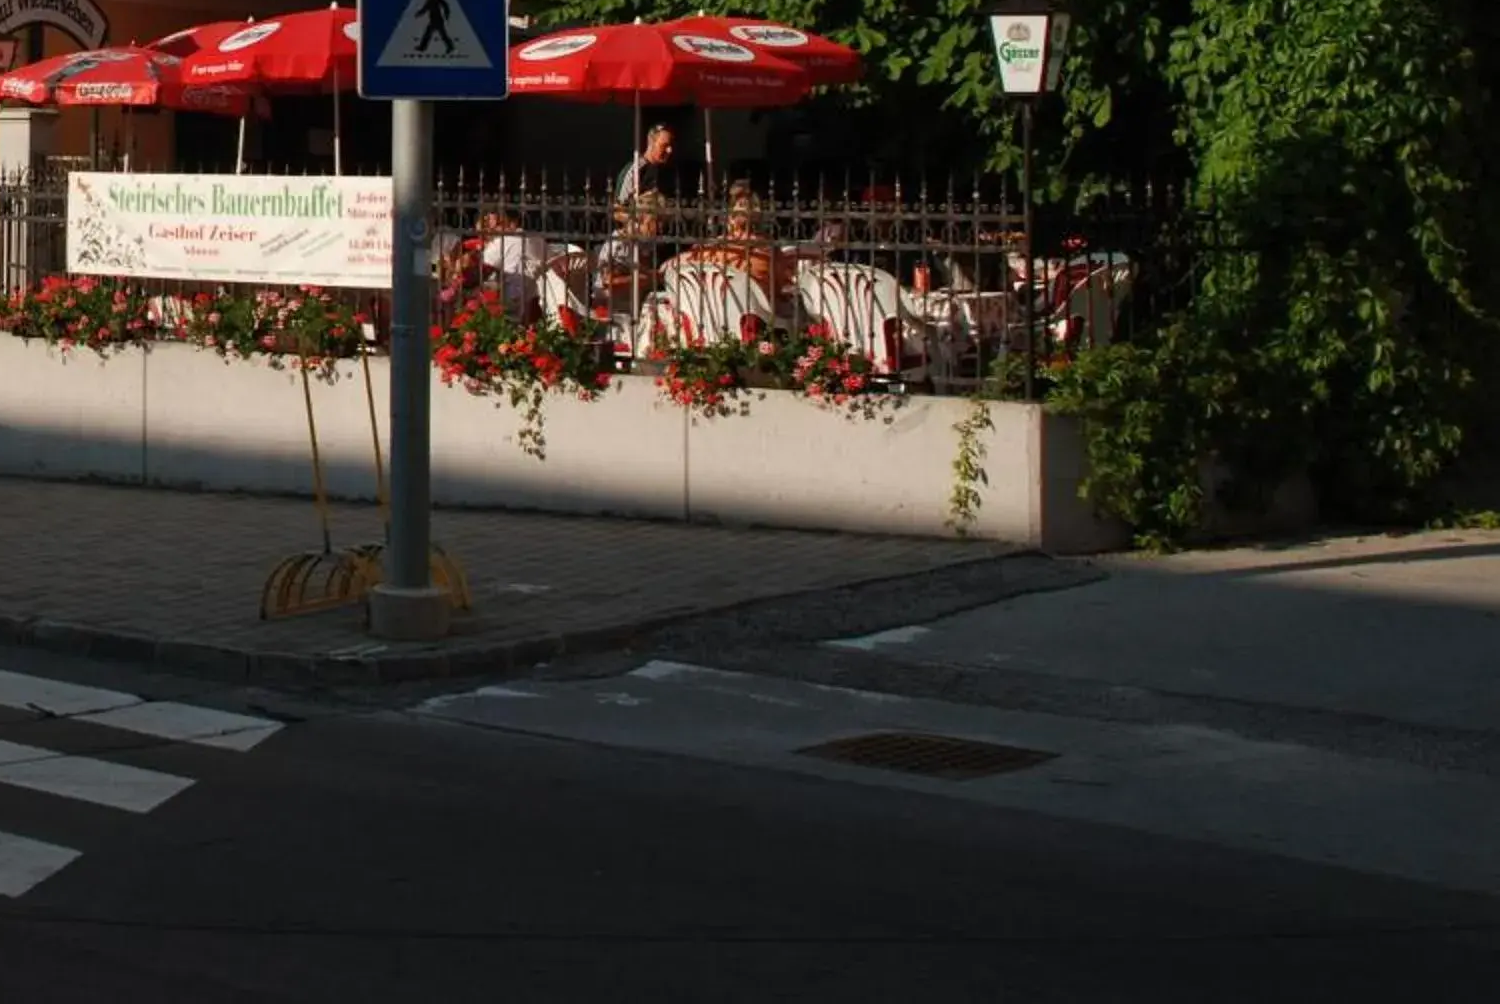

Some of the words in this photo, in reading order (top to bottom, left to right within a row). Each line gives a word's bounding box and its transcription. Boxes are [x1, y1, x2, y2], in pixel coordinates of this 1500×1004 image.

[108, 181, 206, 216] Steirisches
[211, 183, 343, 219] Bauernbuffet
[148, 222, 206, 242] Gasthof
[208, 224, 257, 243] Zeiser
